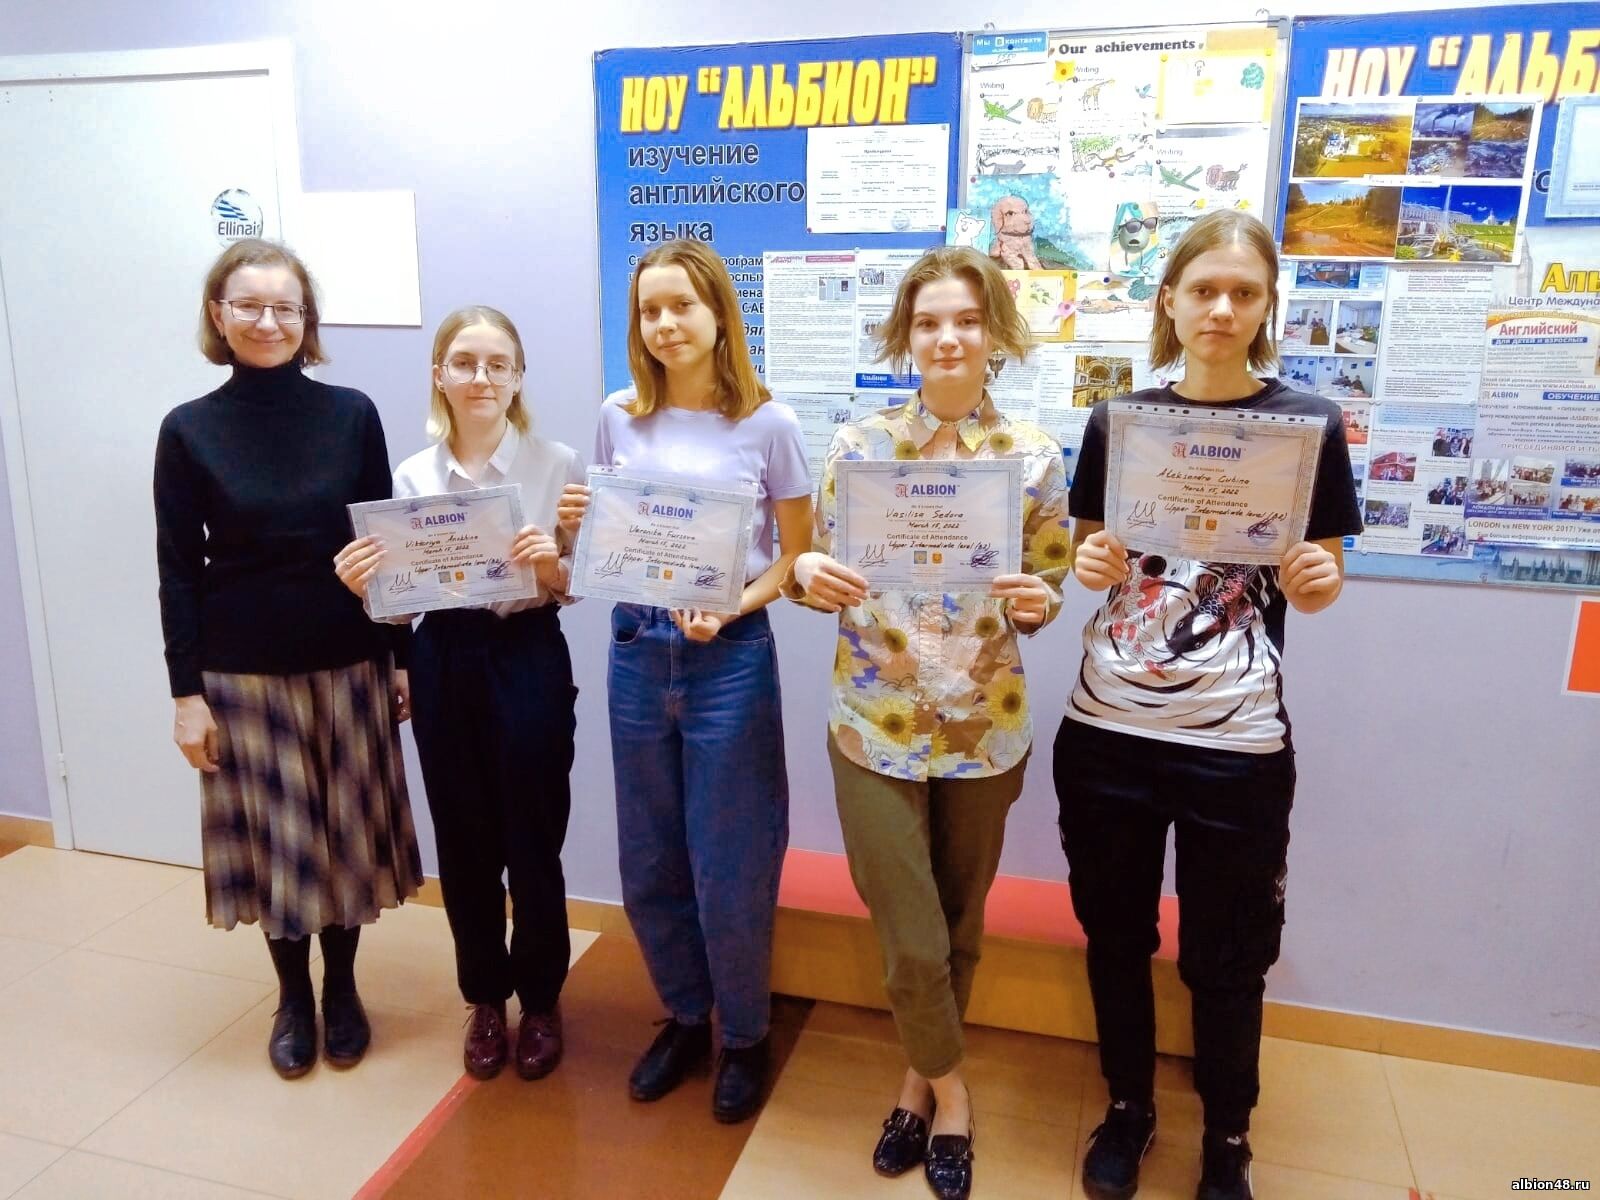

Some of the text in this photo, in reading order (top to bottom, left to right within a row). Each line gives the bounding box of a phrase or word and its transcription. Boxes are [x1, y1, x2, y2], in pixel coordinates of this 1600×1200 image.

[976, 38, 990, 46] Мы
[1059, 39, 1195, 55] Our achievements
[1321, 46, 1417, 97] НОУ
[620, 75, 689, 133] НОУ
[628, 143, 759, 173] изучение
[629, 177, 806, 206] английского
[630, 221, 714, 243] языка
[1508, 296, 1543, 307] Центр
[1499, 321, 1578, 336] Английский
[1491, 391, 1519, 399] ALBION
[1189, 444, 1242, 459] ALBION
[911, 484, 956, 495] ALBION
[1158, 494, 1195, 504] Certificate
[1206, 499, 1249, 508] Attendance
[425, 512, 465, 526] ALBION
[652, 504, 694, 519] ALBION
[1468, 521, 1500, 529] LONDON
[411, 557, 442, 566] Certificate
[450, 553, 484, 561] Attendance
[624, 546, 656, 556] Certificate
[664, 551, 699, 562] Attendance
